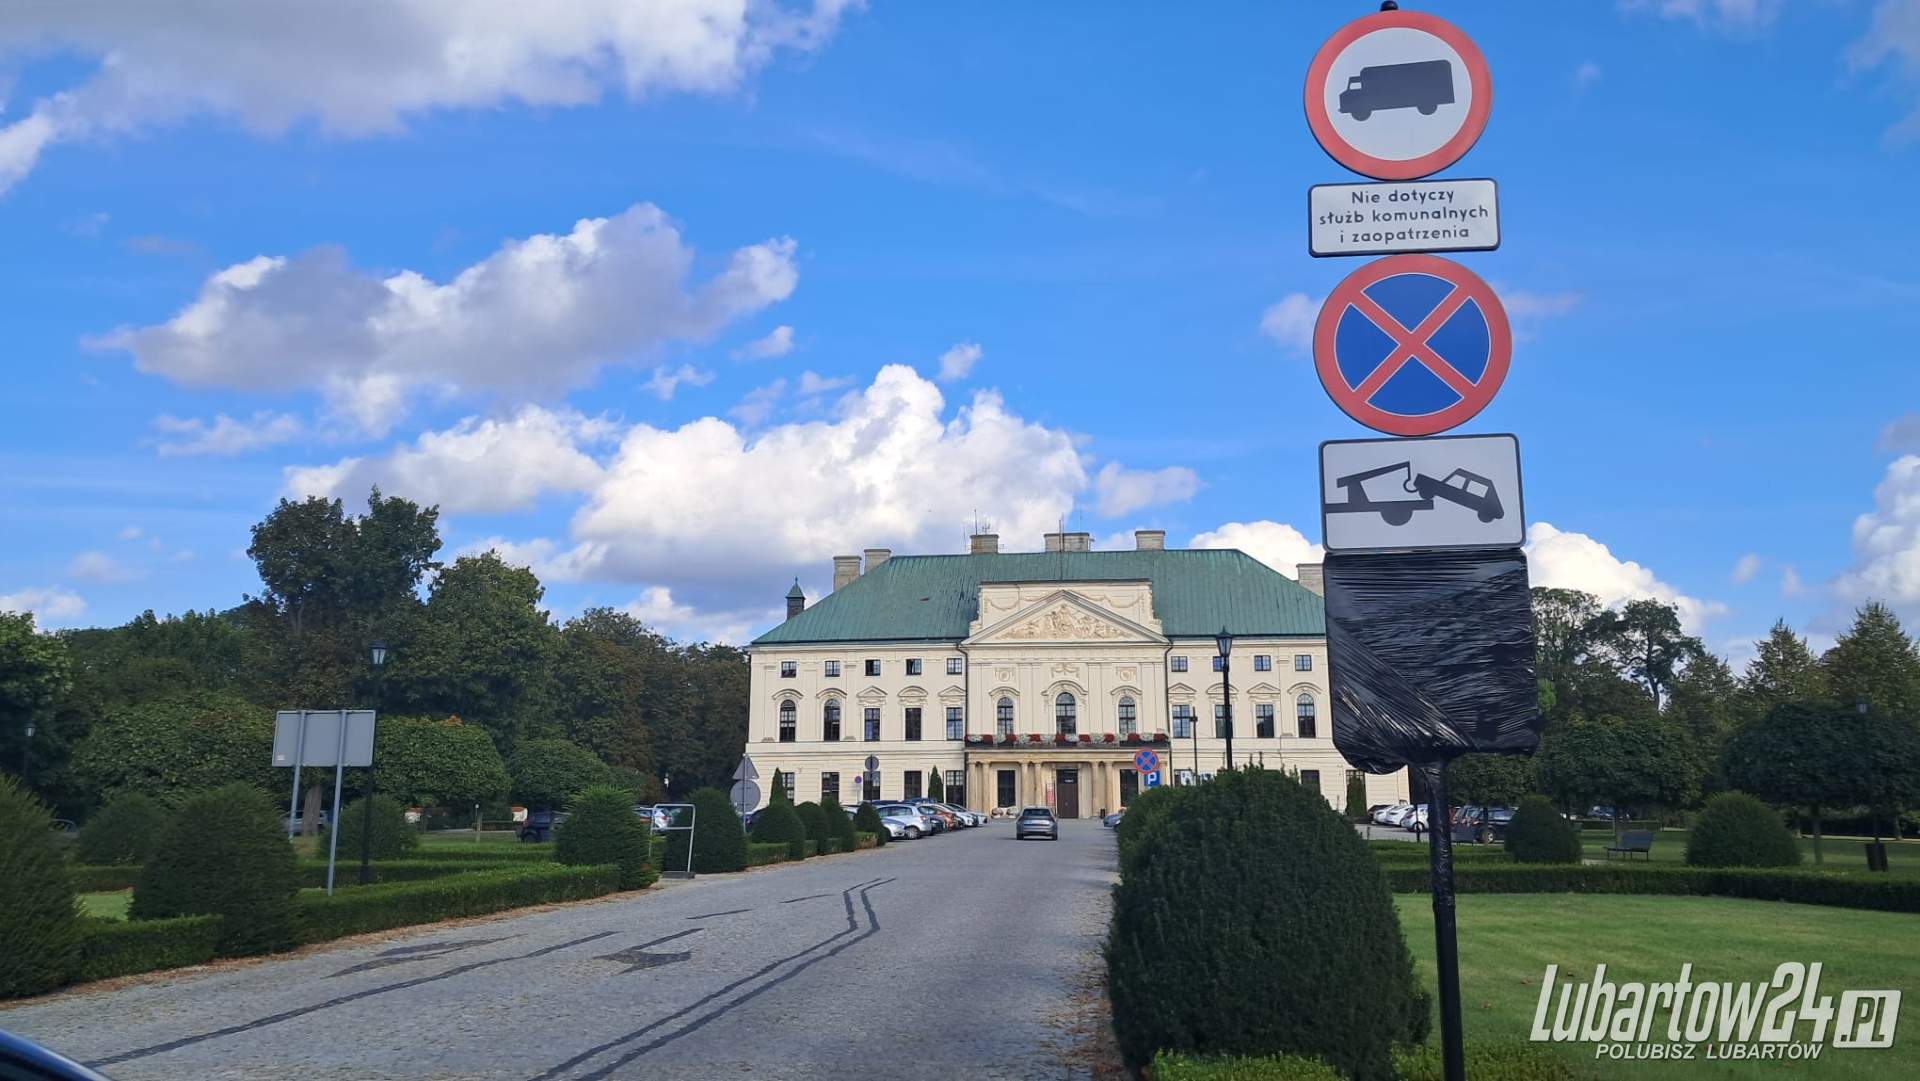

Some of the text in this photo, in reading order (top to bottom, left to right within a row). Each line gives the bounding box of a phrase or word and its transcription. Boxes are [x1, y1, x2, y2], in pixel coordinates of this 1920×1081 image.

[1352, 189, 1454, 205] Nie dotyczy
[1320, 205, 1488, 225] służb komunalnych
[1340, 225, 1469, 245] i zaopatrzenia
[1147, 772, 1157, 784] P
